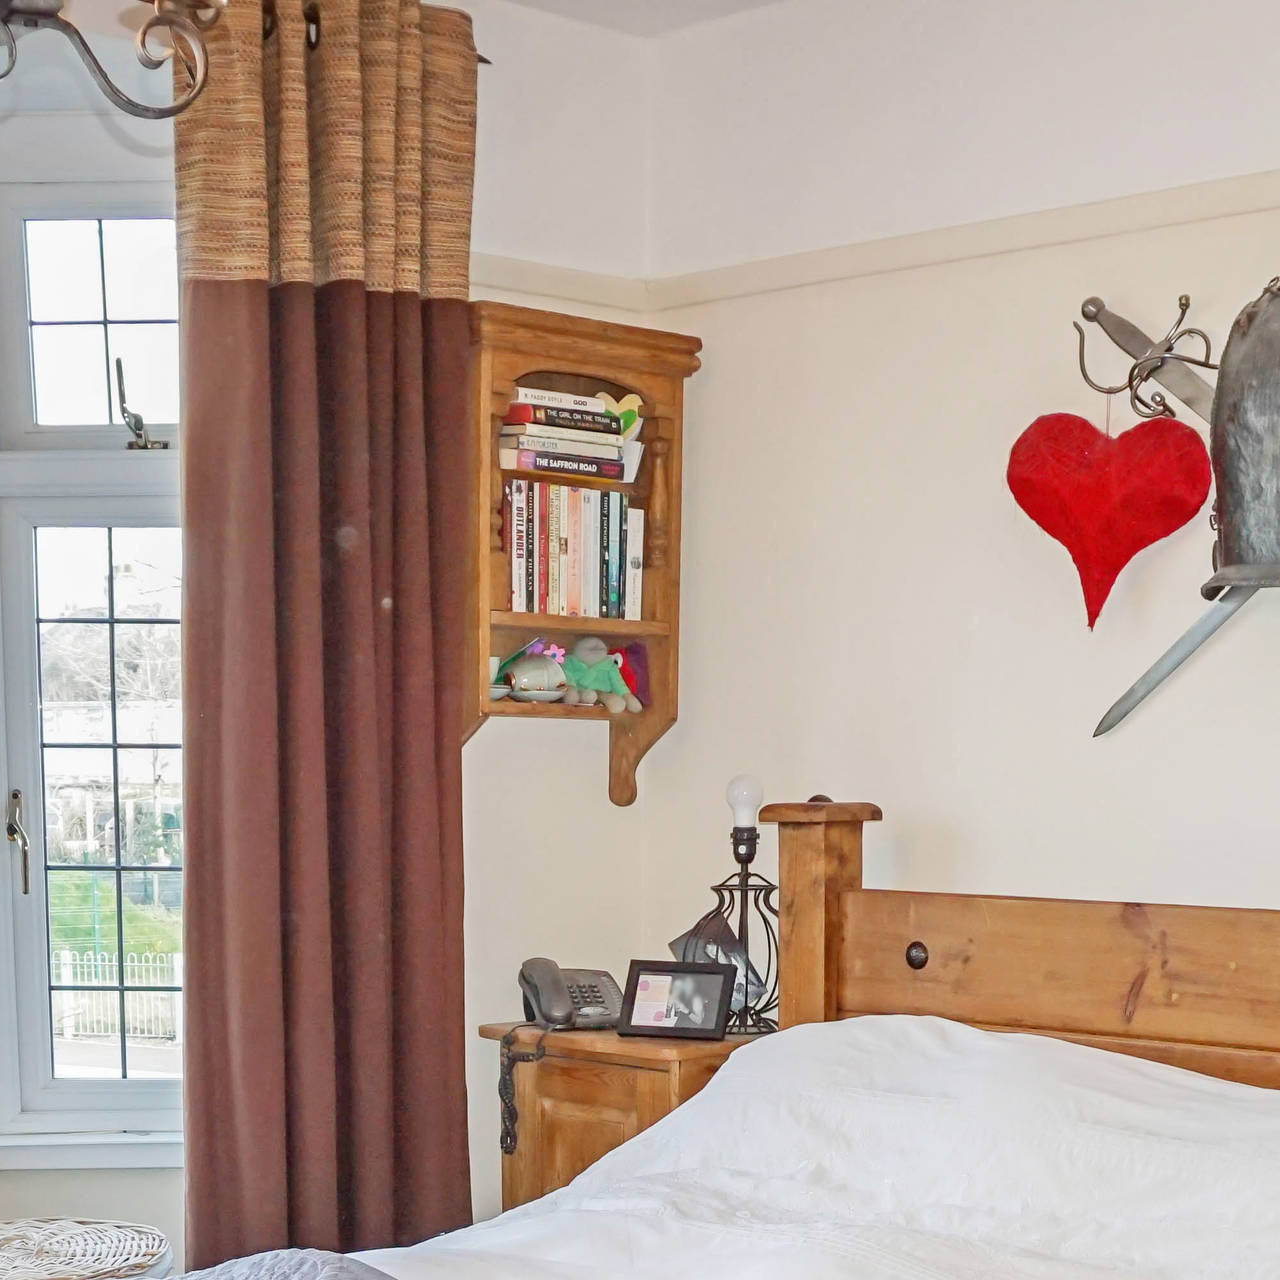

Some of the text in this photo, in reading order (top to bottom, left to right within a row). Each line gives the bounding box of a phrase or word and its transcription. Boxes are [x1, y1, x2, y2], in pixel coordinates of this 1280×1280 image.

[546, 409, 558, 417] THE
[558, 411, 572, 419] GIRL
[582, 414, 594, 422] THE
[594, 416, 611, 424] TRAIN
[535, 458, 549, 467] THE
[549, 459, 579, 471] SAFFRON
[579, 462, 598, 473] ROAD
[515, 506, 524, 559] OUTLANDER
